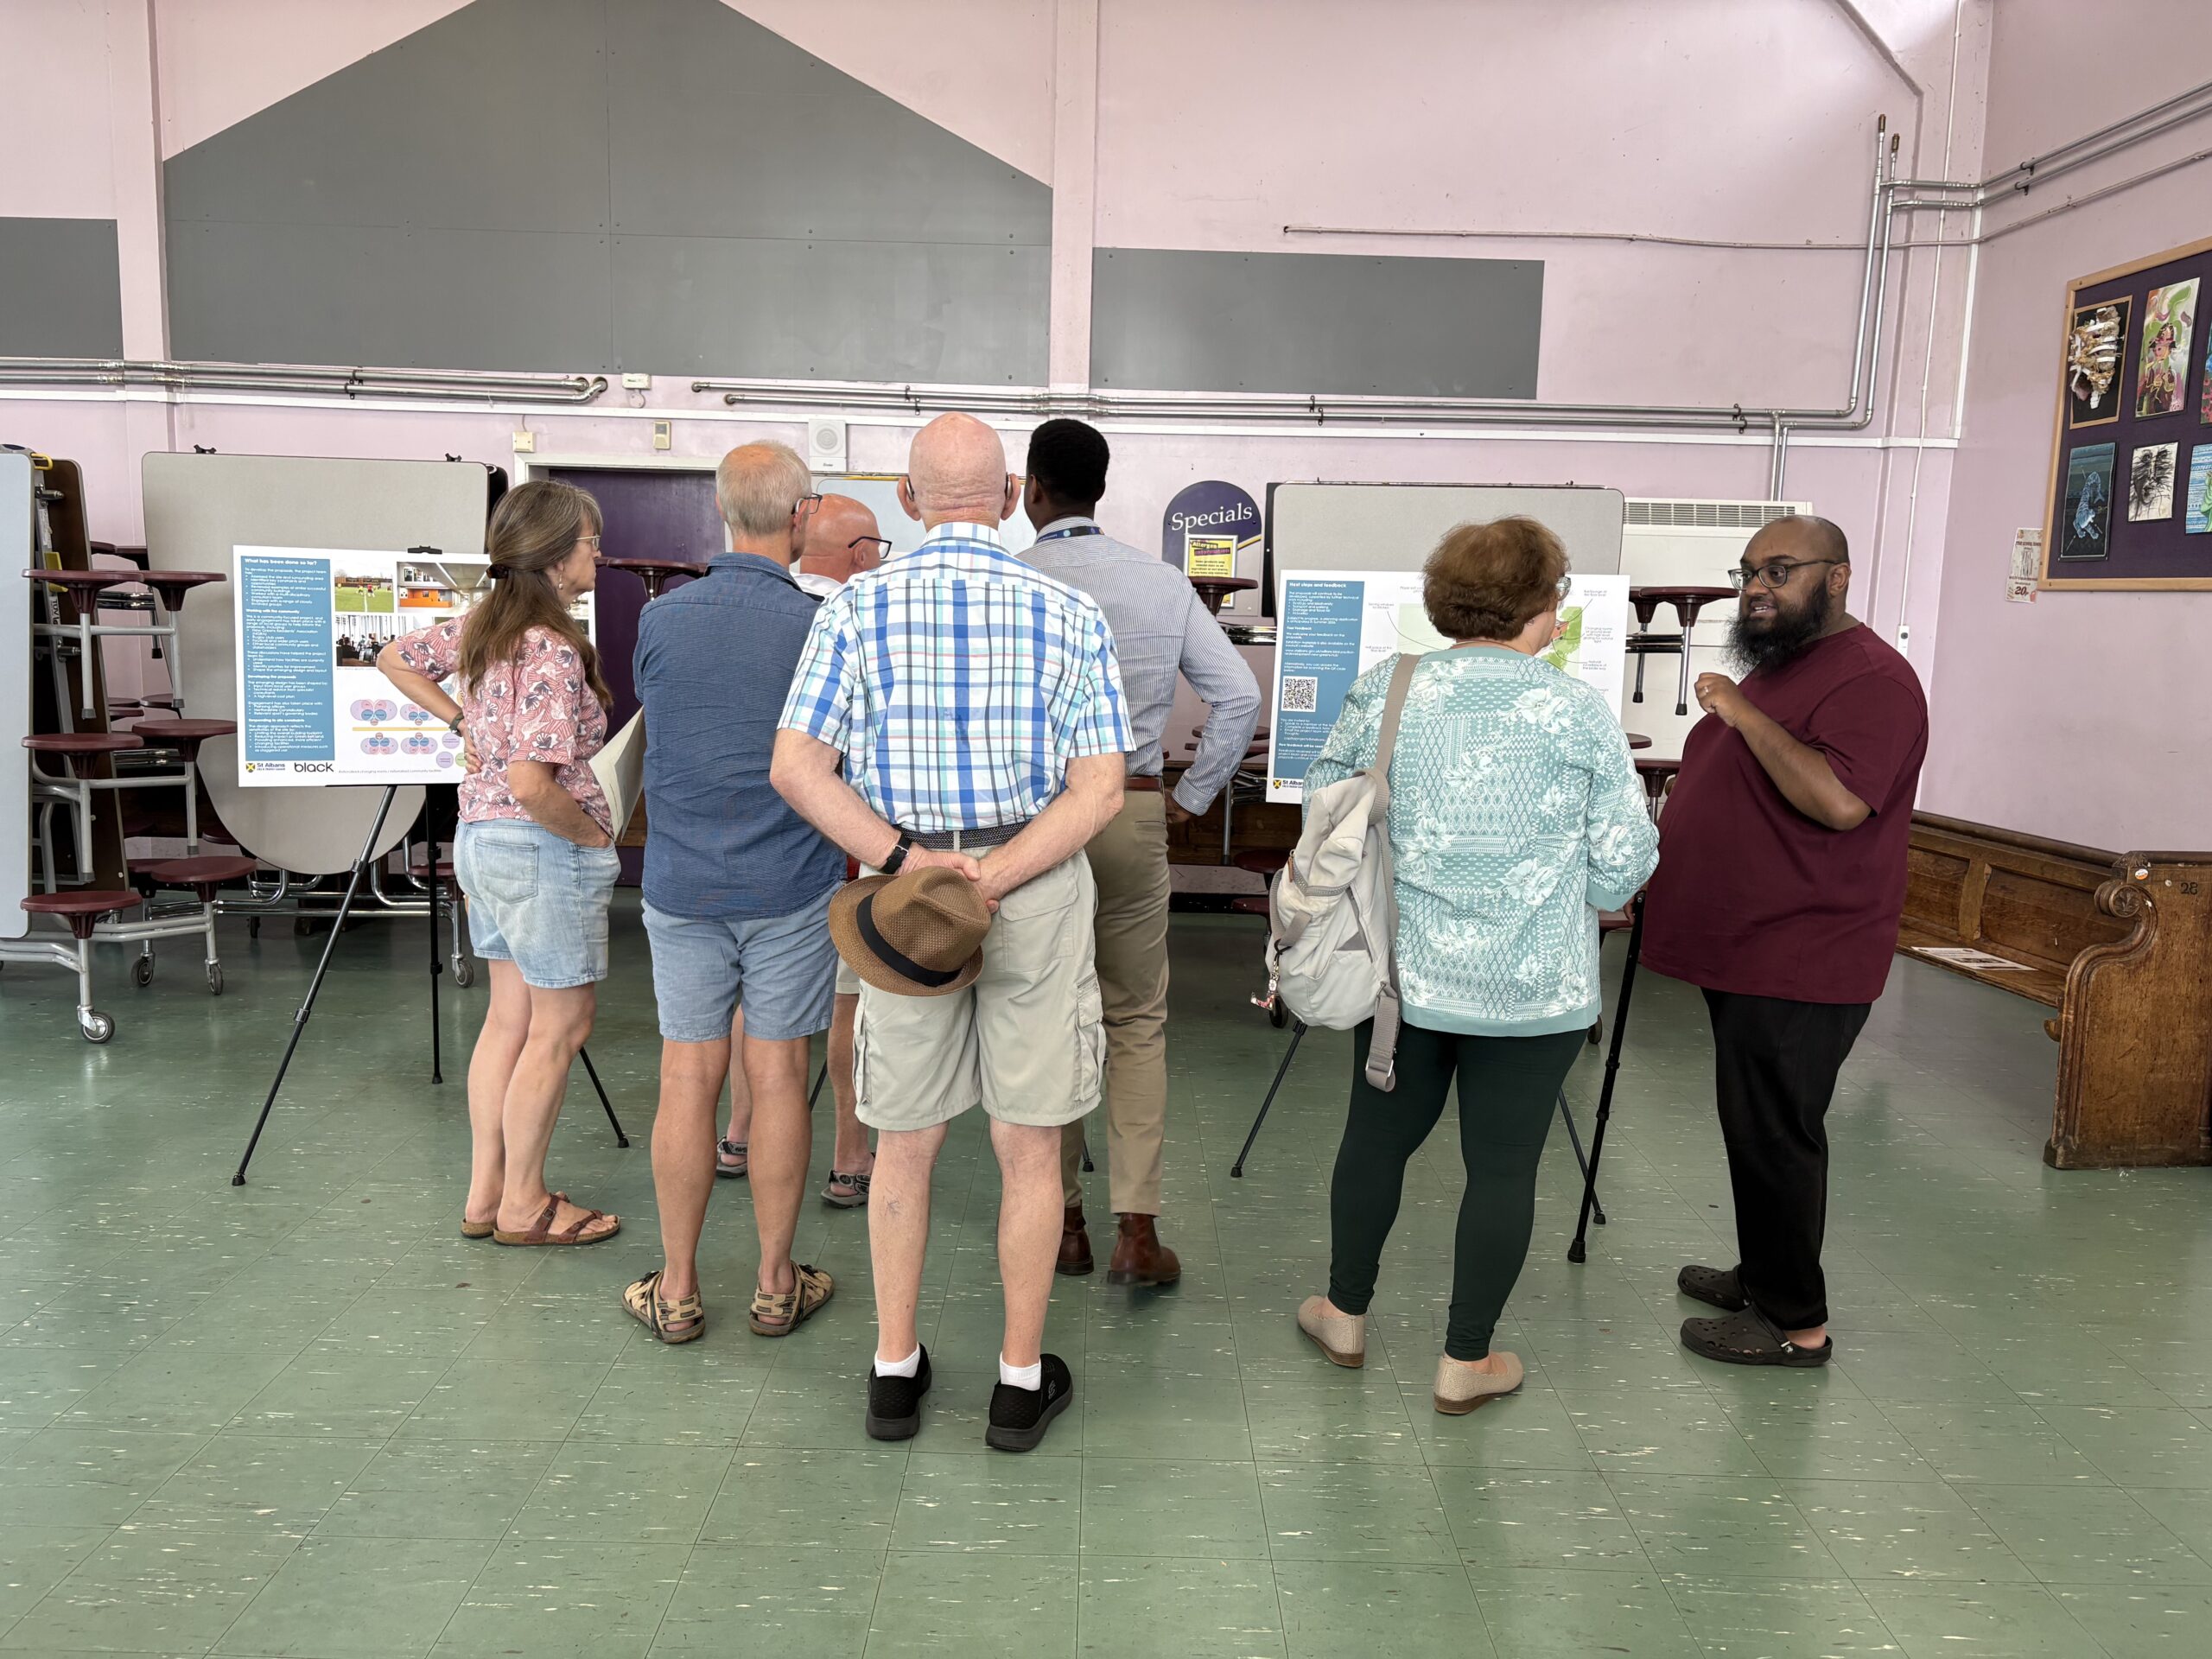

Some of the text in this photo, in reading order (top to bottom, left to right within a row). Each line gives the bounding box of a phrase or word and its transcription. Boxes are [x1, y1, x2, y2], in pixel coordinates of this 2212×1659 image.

[1172, 503, 1253, 535] Specials
[295, 762, 334, 772] black
[2180, 882, 2198, 895] 28
